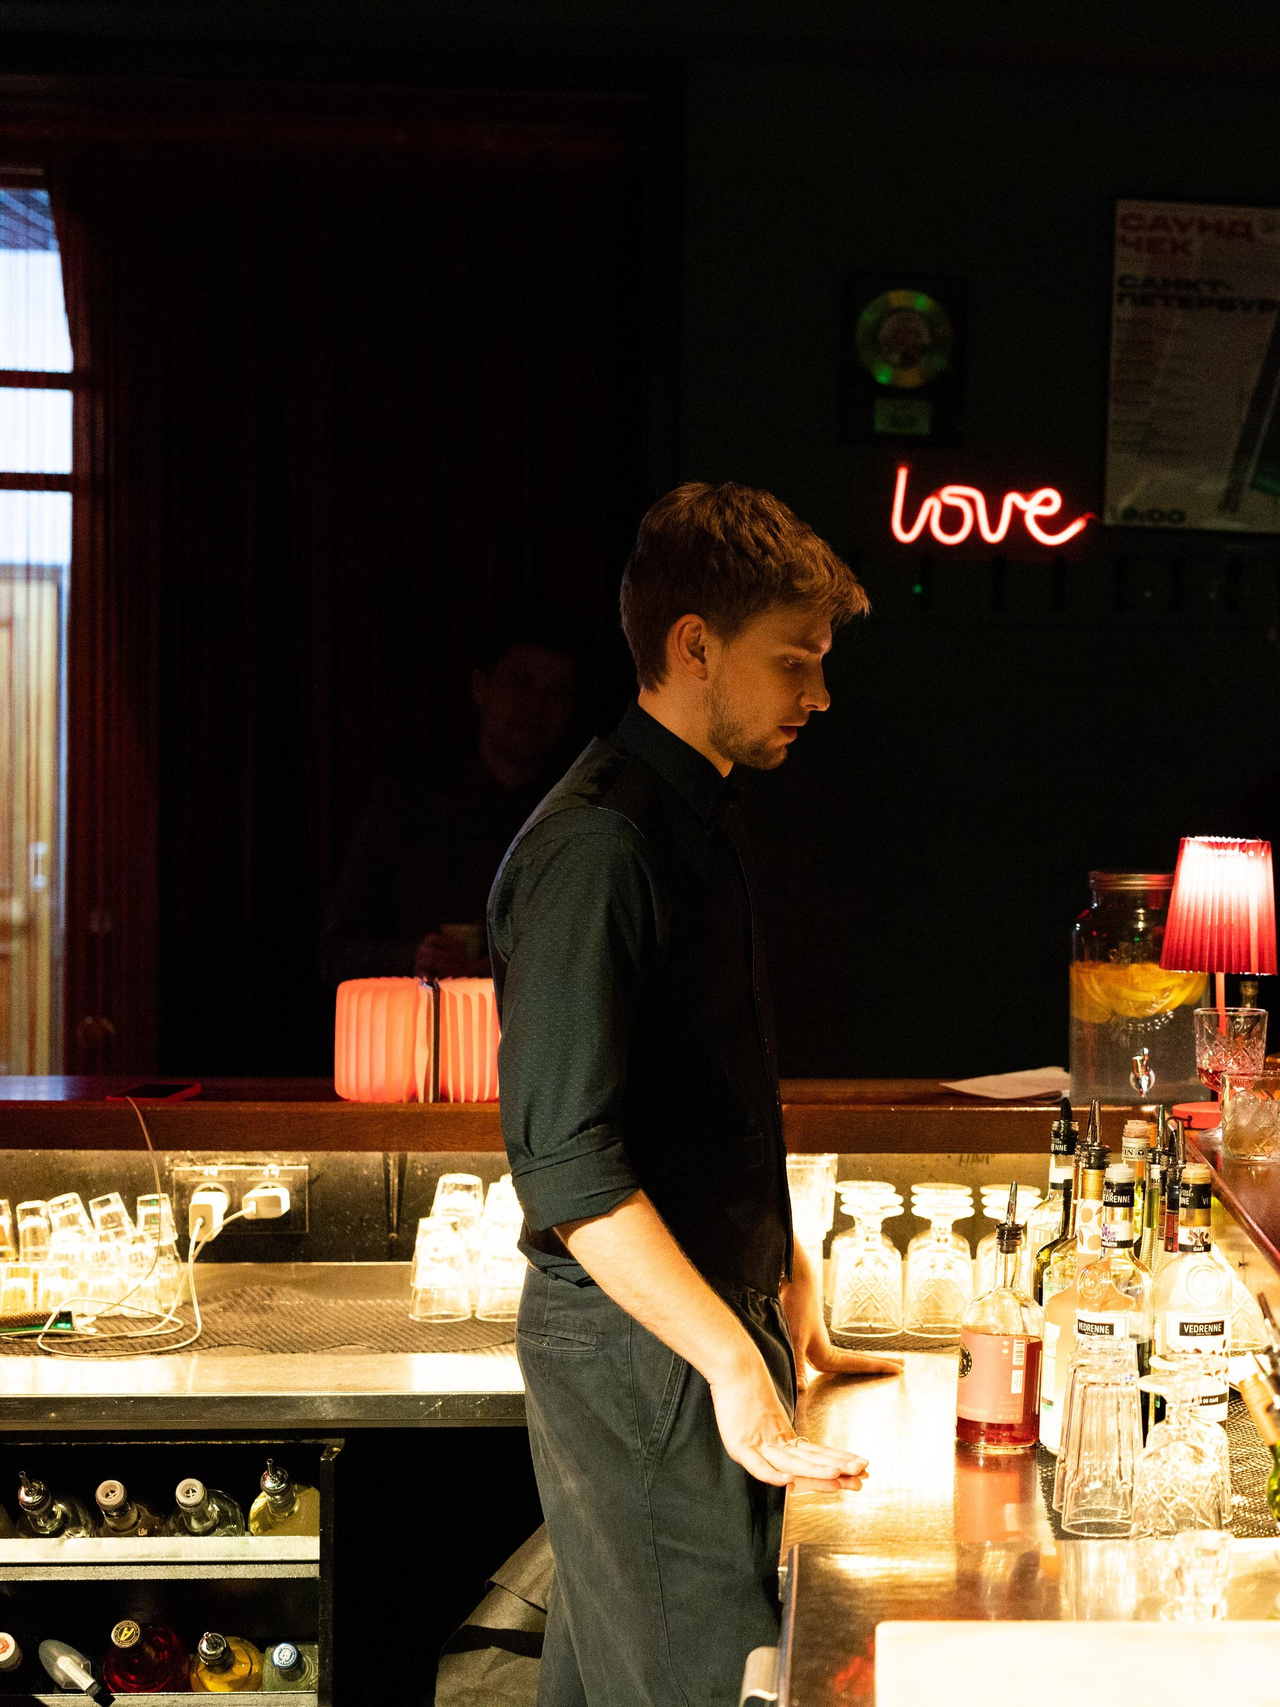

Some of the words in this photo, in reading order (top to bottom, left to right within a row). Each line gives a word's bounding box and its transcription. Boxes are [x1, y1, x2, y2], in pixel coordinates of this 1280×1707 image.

[1119, 212, 1254, 241] САУНД
[1118, 236, 1195, 257] ЧЕК
[1117, 273, 1233, 294] САНКТ-
[891, 466, 1088, 546] love
[1183, 1322, 1222, 1335] VEDRENNE
